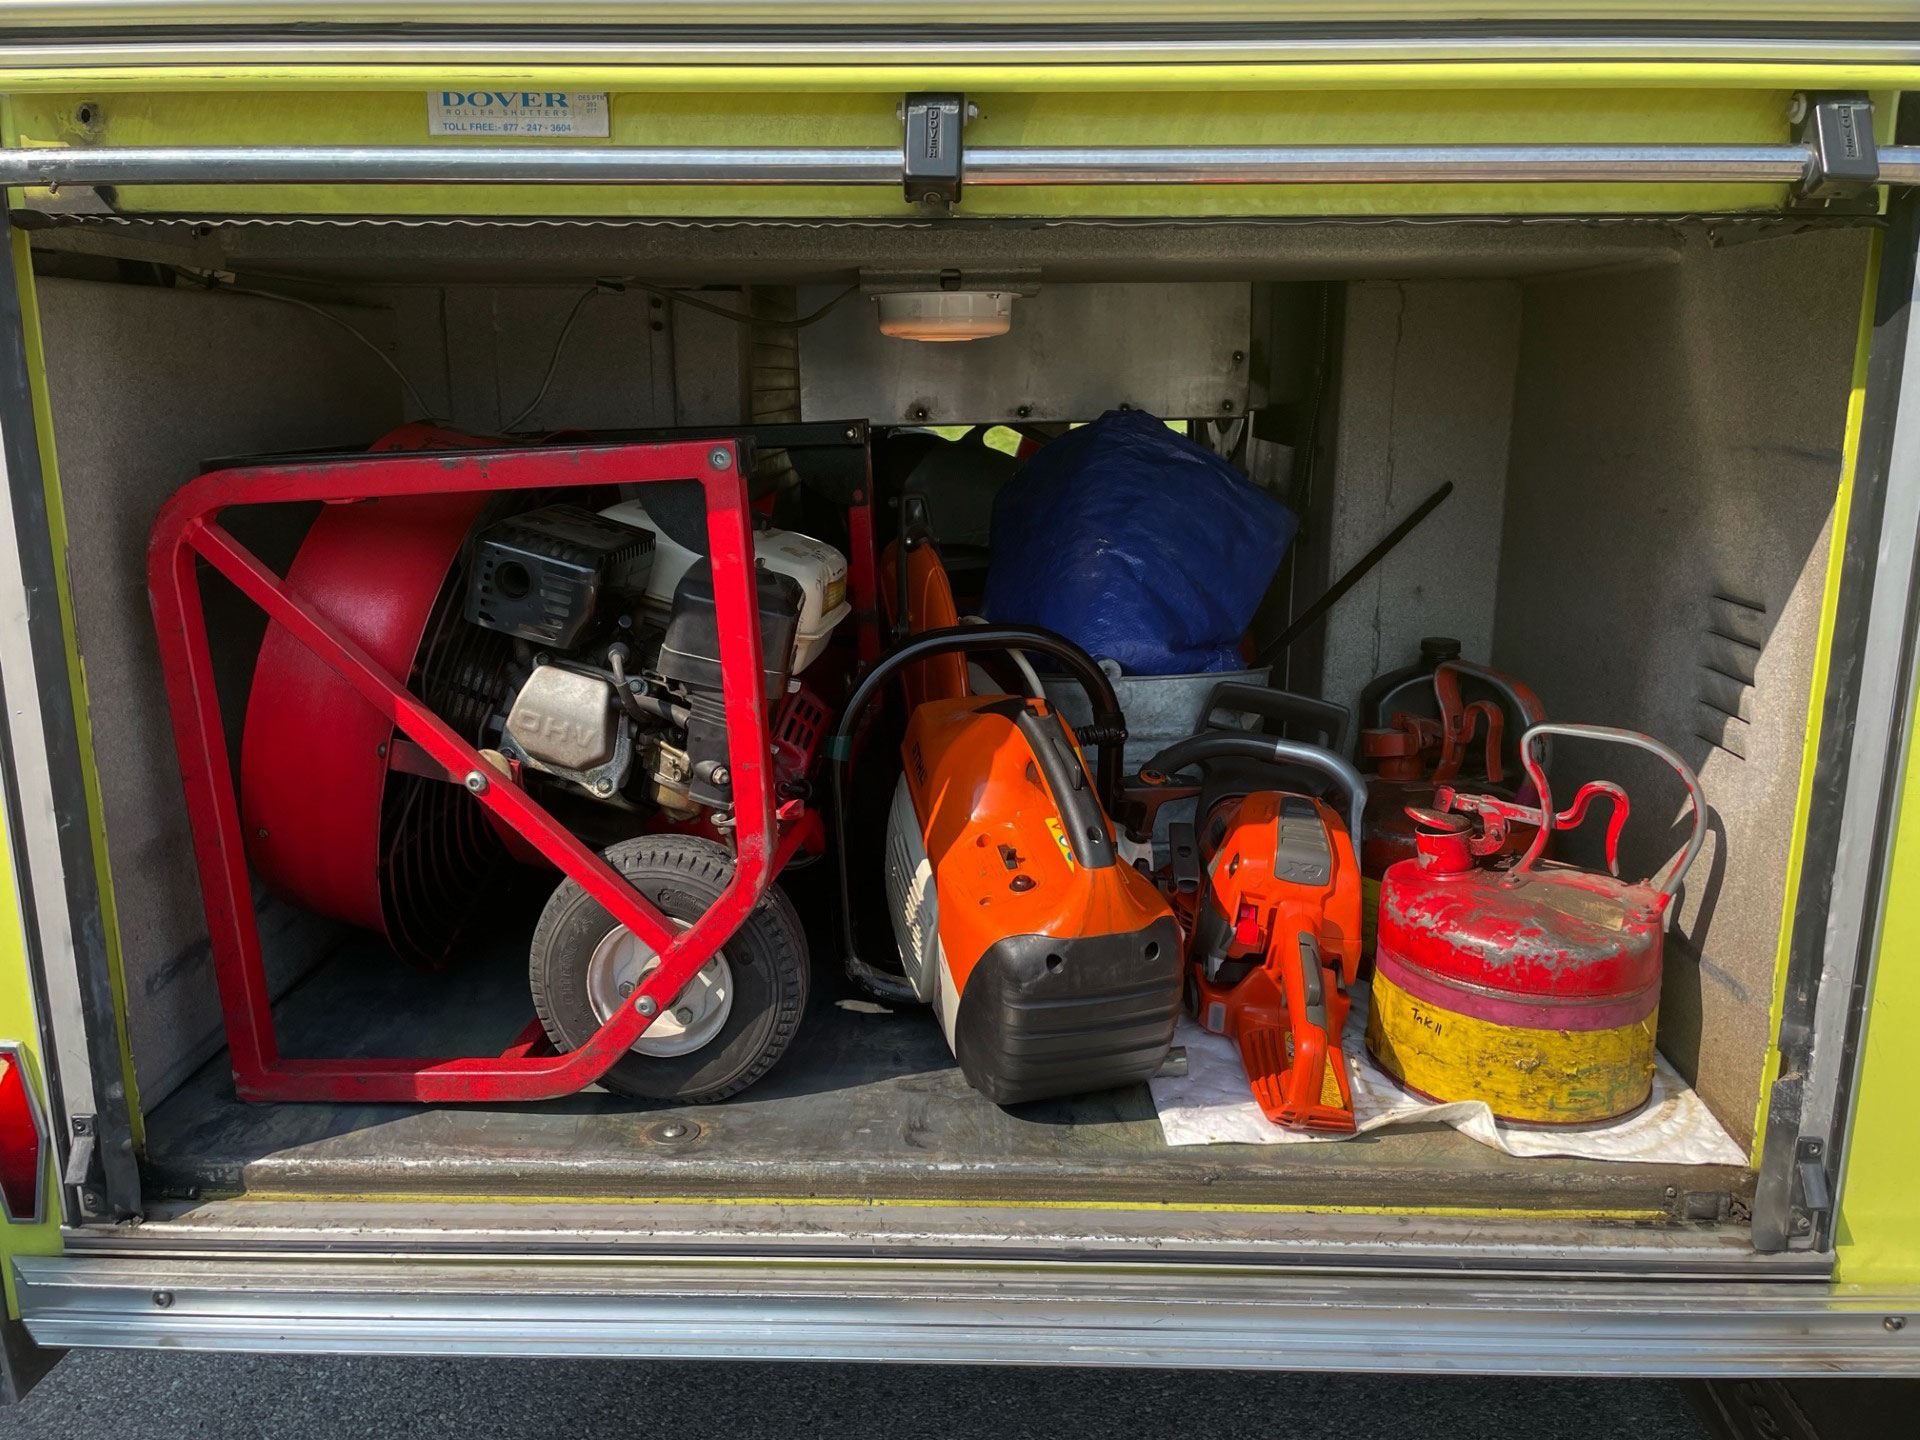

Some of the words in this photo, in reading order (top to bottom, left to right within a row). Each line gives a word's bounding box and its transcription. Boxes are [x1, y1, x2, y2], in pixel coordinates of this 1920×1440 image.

[442, 91, 569, 108] DOVER
[502, 109, 568, 117] SHUTTERS
[443, 123, 467, 131] TOLL
[503, 123, 519, 132] 877
[526, 123, 542, 132] 247
[550, 123, 572, 132] 3604
[928, 110, 939, 159] DOVER
[515, 708, 599, 749] OHV
